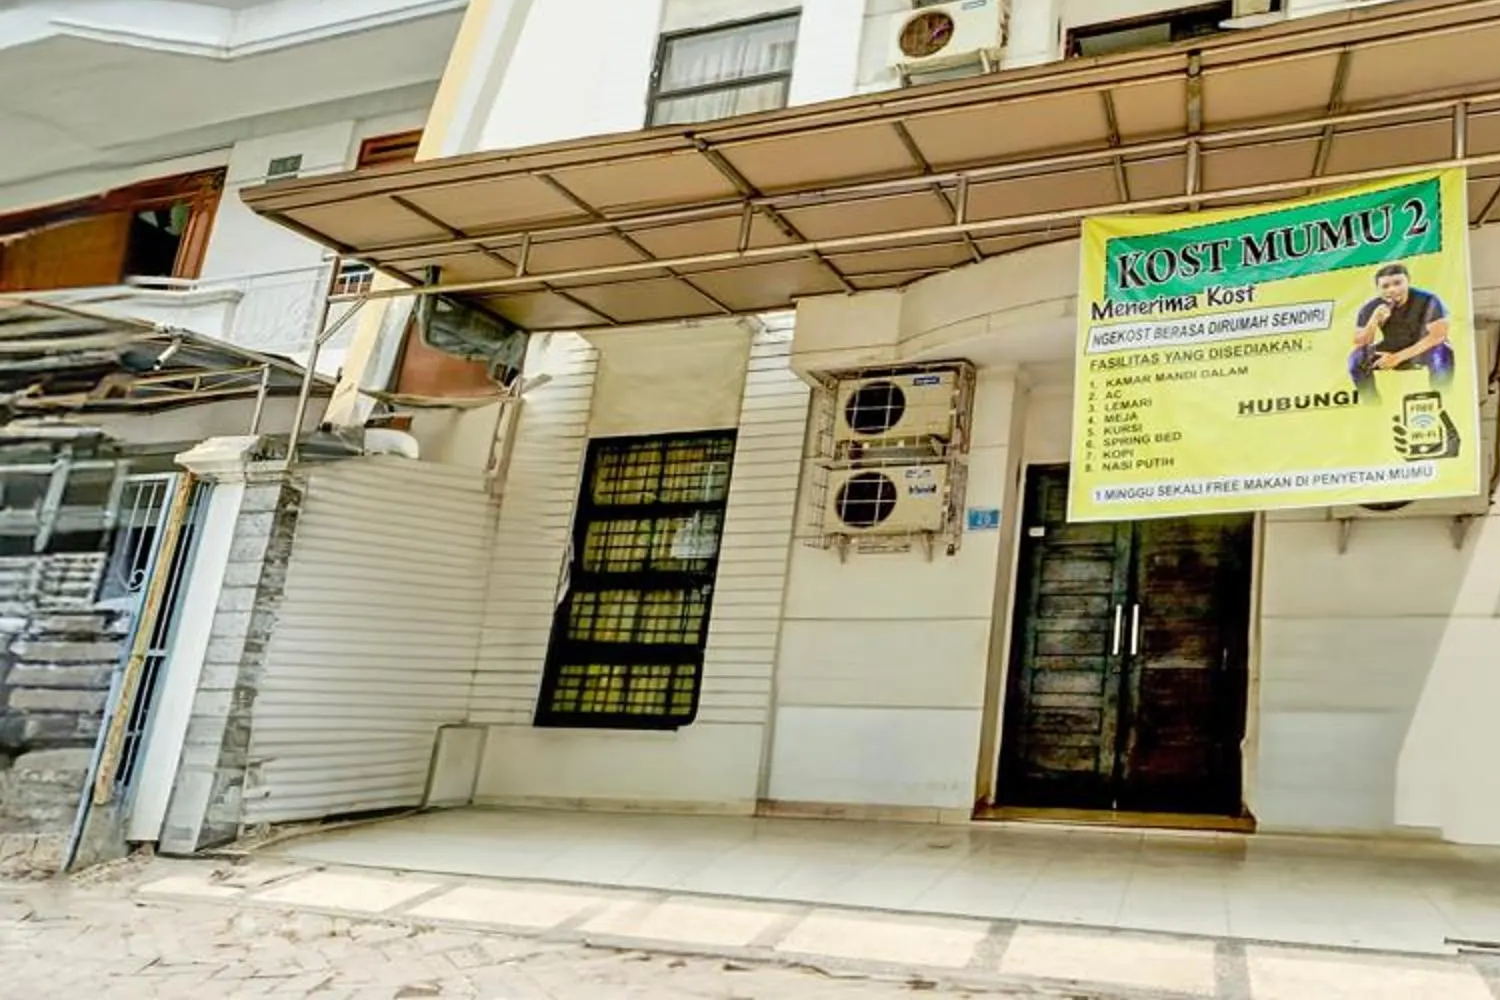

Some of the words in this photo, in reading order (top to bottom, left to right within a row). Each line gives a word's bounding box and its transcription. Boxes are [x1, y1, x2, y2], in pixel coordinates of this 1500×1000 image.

[1117, 239, 1231, 290] KOST
[1241, 205, 1395, 266] MUMU
[1403, 199, 1430, 238] 2
[1091, 296, 1198, 321] Menerima
[1207, 286, 1256, 307] Kost
[1092, 327, 1152, 346] NGEKOST
[1153, 322, 1204, 340] BERASA
[1207, 313, 1269, 335] DIRUMAH
[1271, 308, 1325, 328] SENDIRI
[1090, 352, 1160, 372] FASILITAS
[1164, 348, 1204, 364] YANG
[1208, 339, 1303, 359] DISEDIAKAN
[1105, 375, 1151, 388] KAMAR
[1155, 371, 1197, 382] MANDI
[1200, 366, 1249, 379] DALAM
[1105, 389, 1122, 399] AC
[1238, 390, 1360, 416] HUBUNGI
[1104, 398, 1152, 412] LEMARI
[1104, 411, 1138, 423] MEJA
[1103, 423, 1143, 435] KURSI
[1103, 435, 1150, 447] SPRING
[1154, 431, 1182, 443] BED
[1102, 449, 1134, 459] KOPI
[1102, 460, 1133, 472] NASI
[1136, 457, 1175, 469] PUTIH
[1104, 487, 1154, 500] MINGGU
[1157, 483, 1203, 497] SEKALI
[1205, 480, 1241, 493] FREE
[1244, 477, 1292, 491] MAKAN
[1295, 475, 1309, 487] DI
[1313, 470, 1385, 486] PENYETAN
[1389, 465, 1433, 480] MUMU
